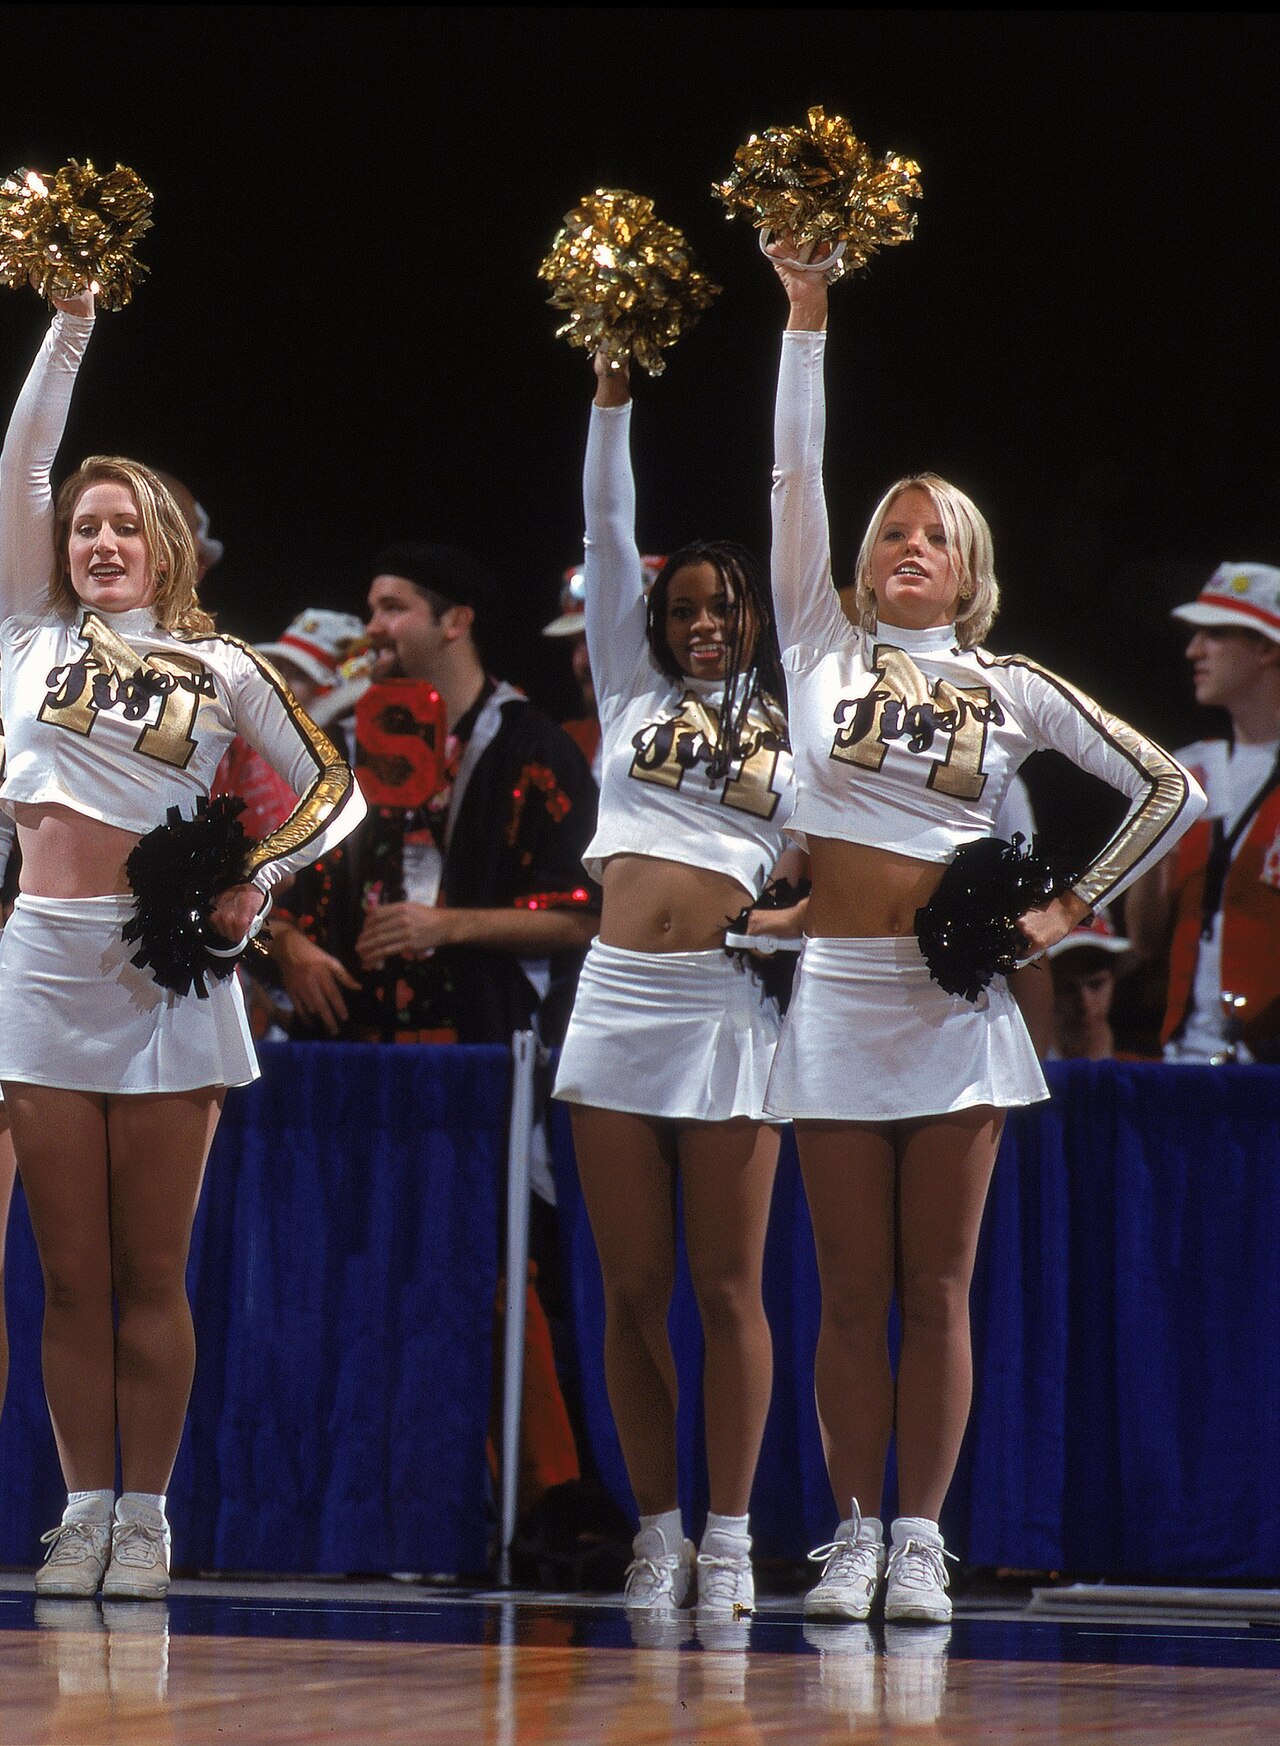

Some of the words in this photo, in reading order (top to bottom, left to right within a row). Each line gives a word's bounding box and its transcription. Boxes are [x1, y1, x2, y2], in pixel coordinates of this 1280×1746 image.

[46, 658, 218, 721] Tigers
[631, 719, 793, 780] Tiger
[833, 690, 1006, 754] Tigers
